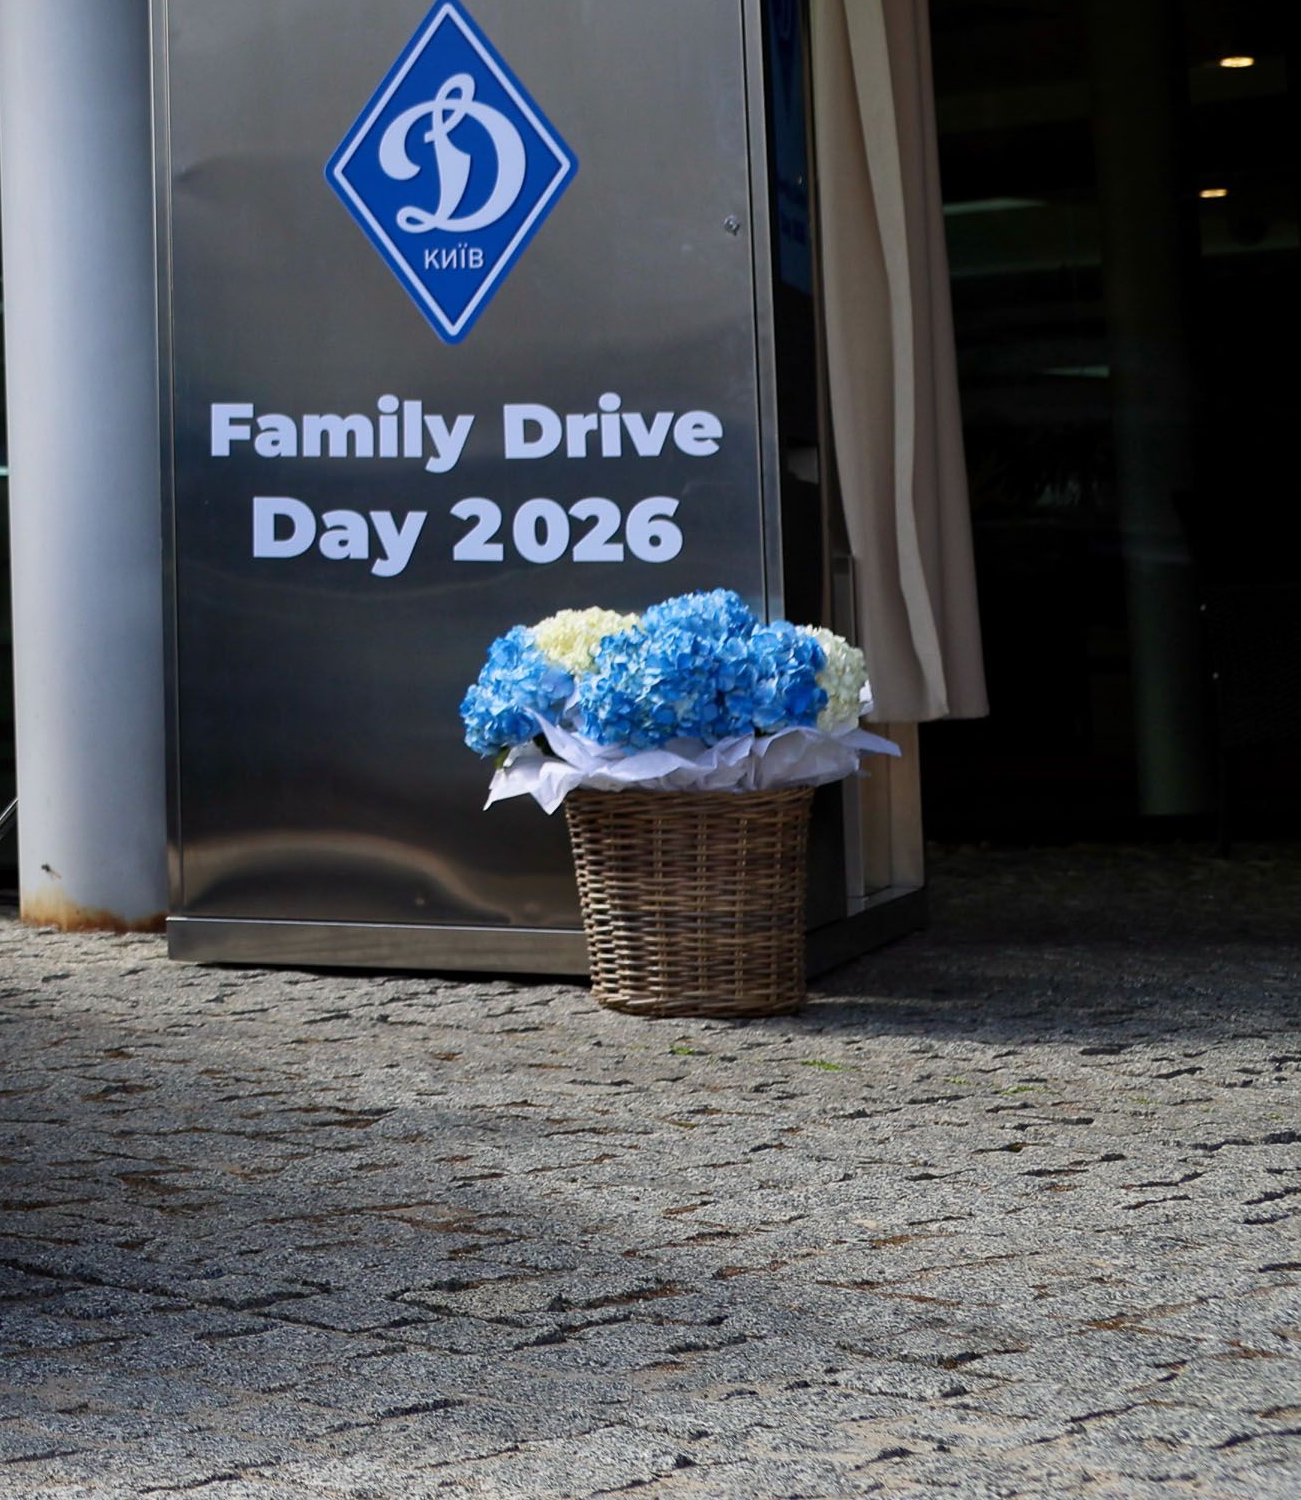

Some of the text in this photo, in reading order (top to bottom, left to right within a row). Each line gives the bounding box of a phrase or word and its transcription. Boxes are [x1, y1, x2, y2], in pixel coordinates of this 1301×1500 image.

[425, 243, 484, 269] КИЇВ
[211, 393, 723, 473] Family Drive
[253, 496, 683, 577] Day 2026
